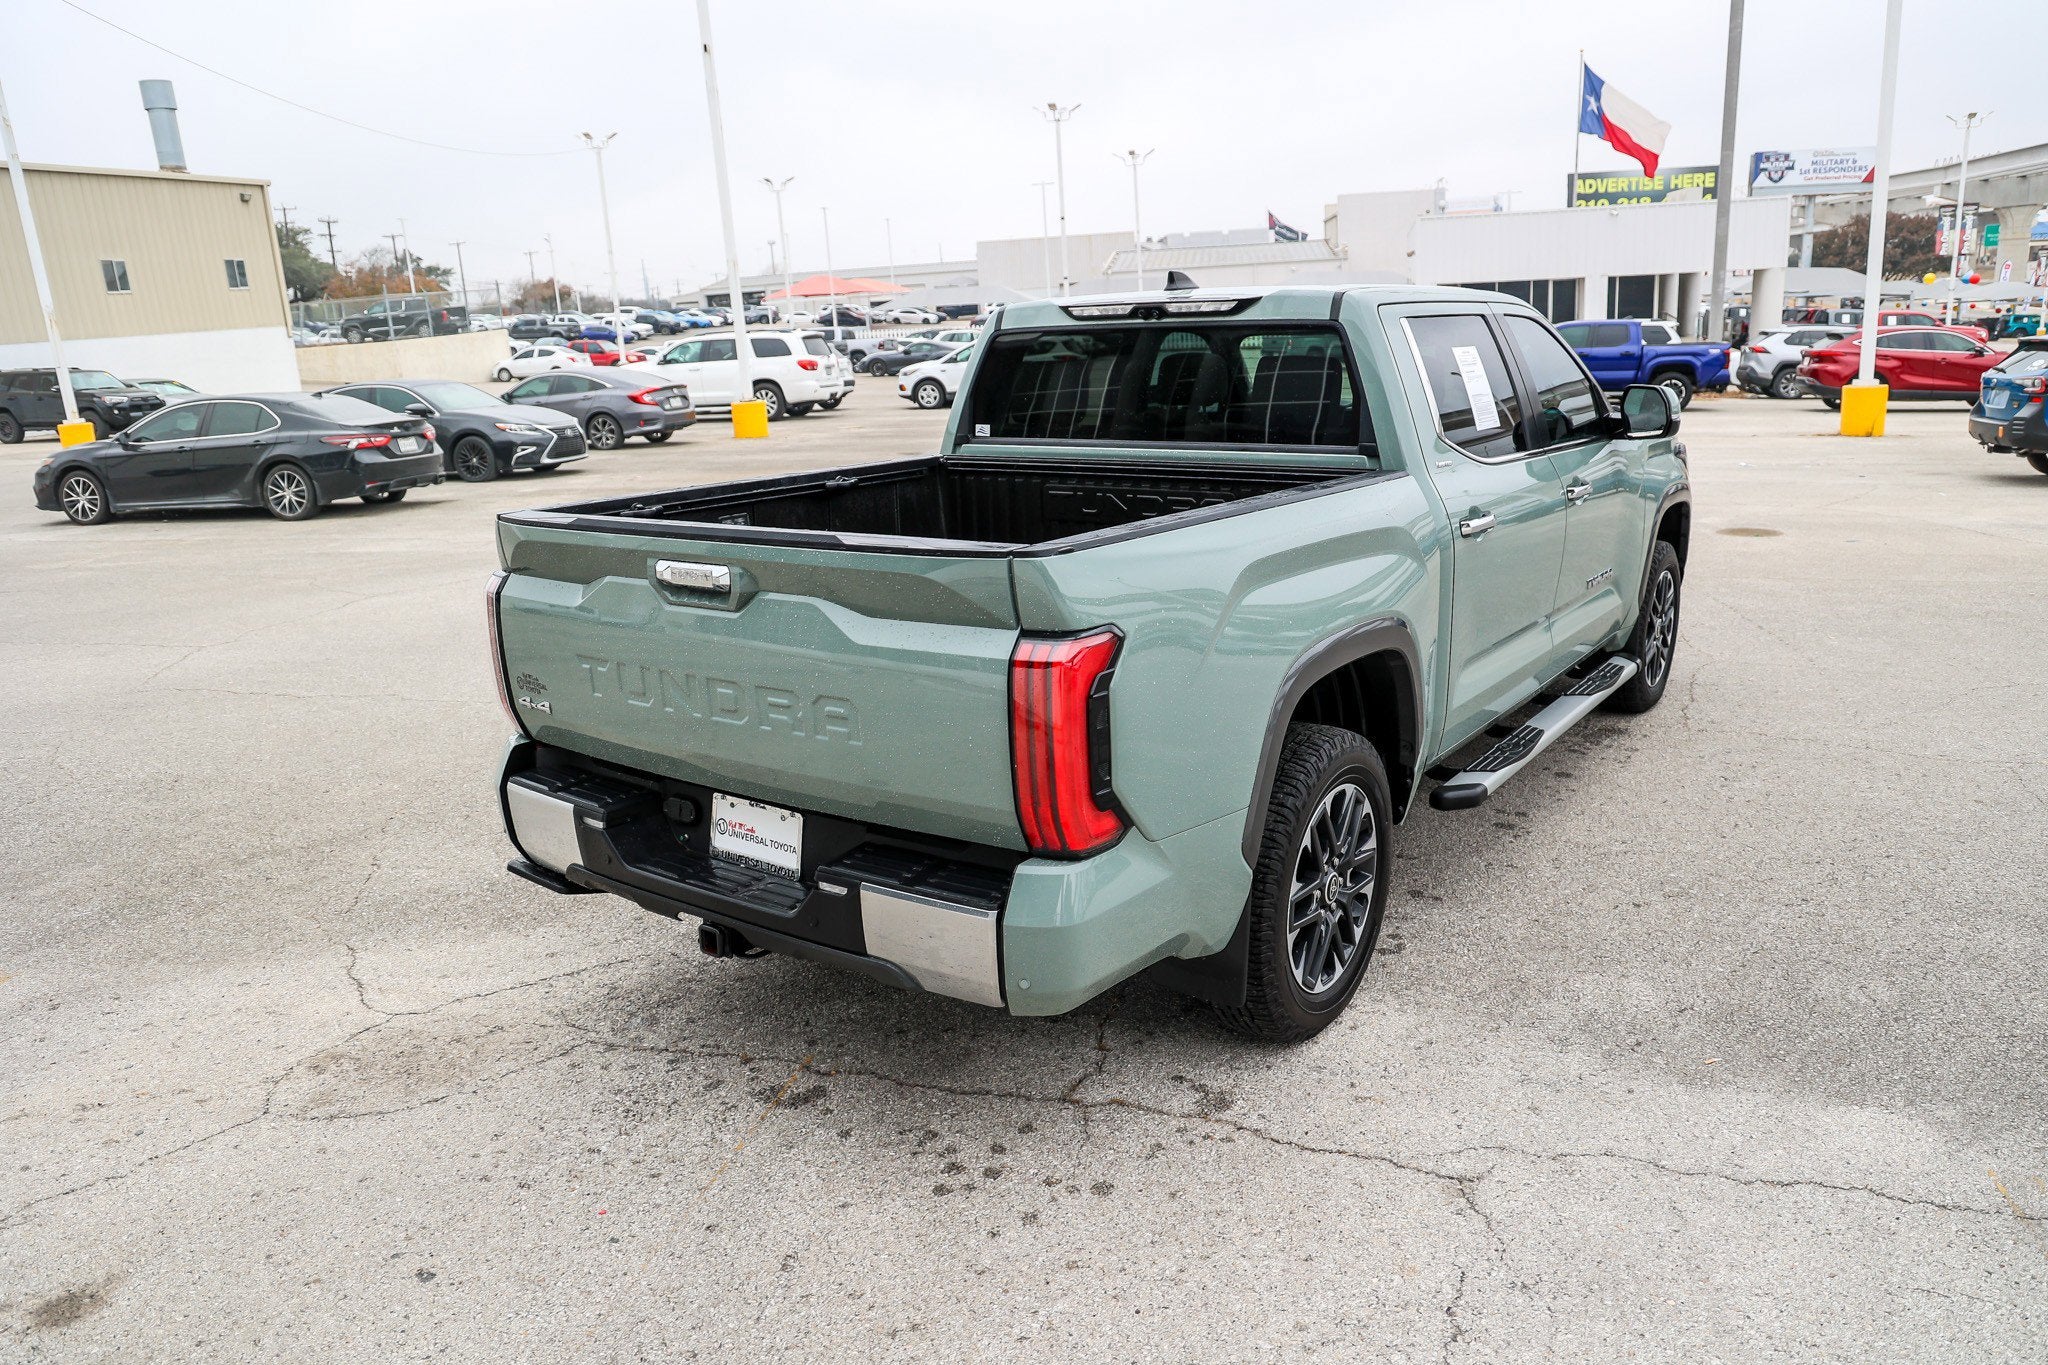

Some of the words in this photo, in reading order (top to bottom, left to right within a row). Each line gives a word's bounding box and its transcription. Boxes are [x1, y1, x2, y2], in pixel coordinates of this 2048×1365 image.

[1811, 158, 1850, 166] MILITARY
[1812, 164, 1869, 174] RESPONDERS
[1577, 176, 1664, 194] ADVERTISE
[1670, 172, 1716, 189] HERE
[519, 696, 552, 715] 4x4
[576, 654, 863, 746] TUNDRA
[728, 829, 769, 847] UNIVERSAL
[770, 840, 798, 855] TOYOTA
[721, 850, 764, 869] UNIVERSAL
[767, 863, 797, 879] TOYOTA
